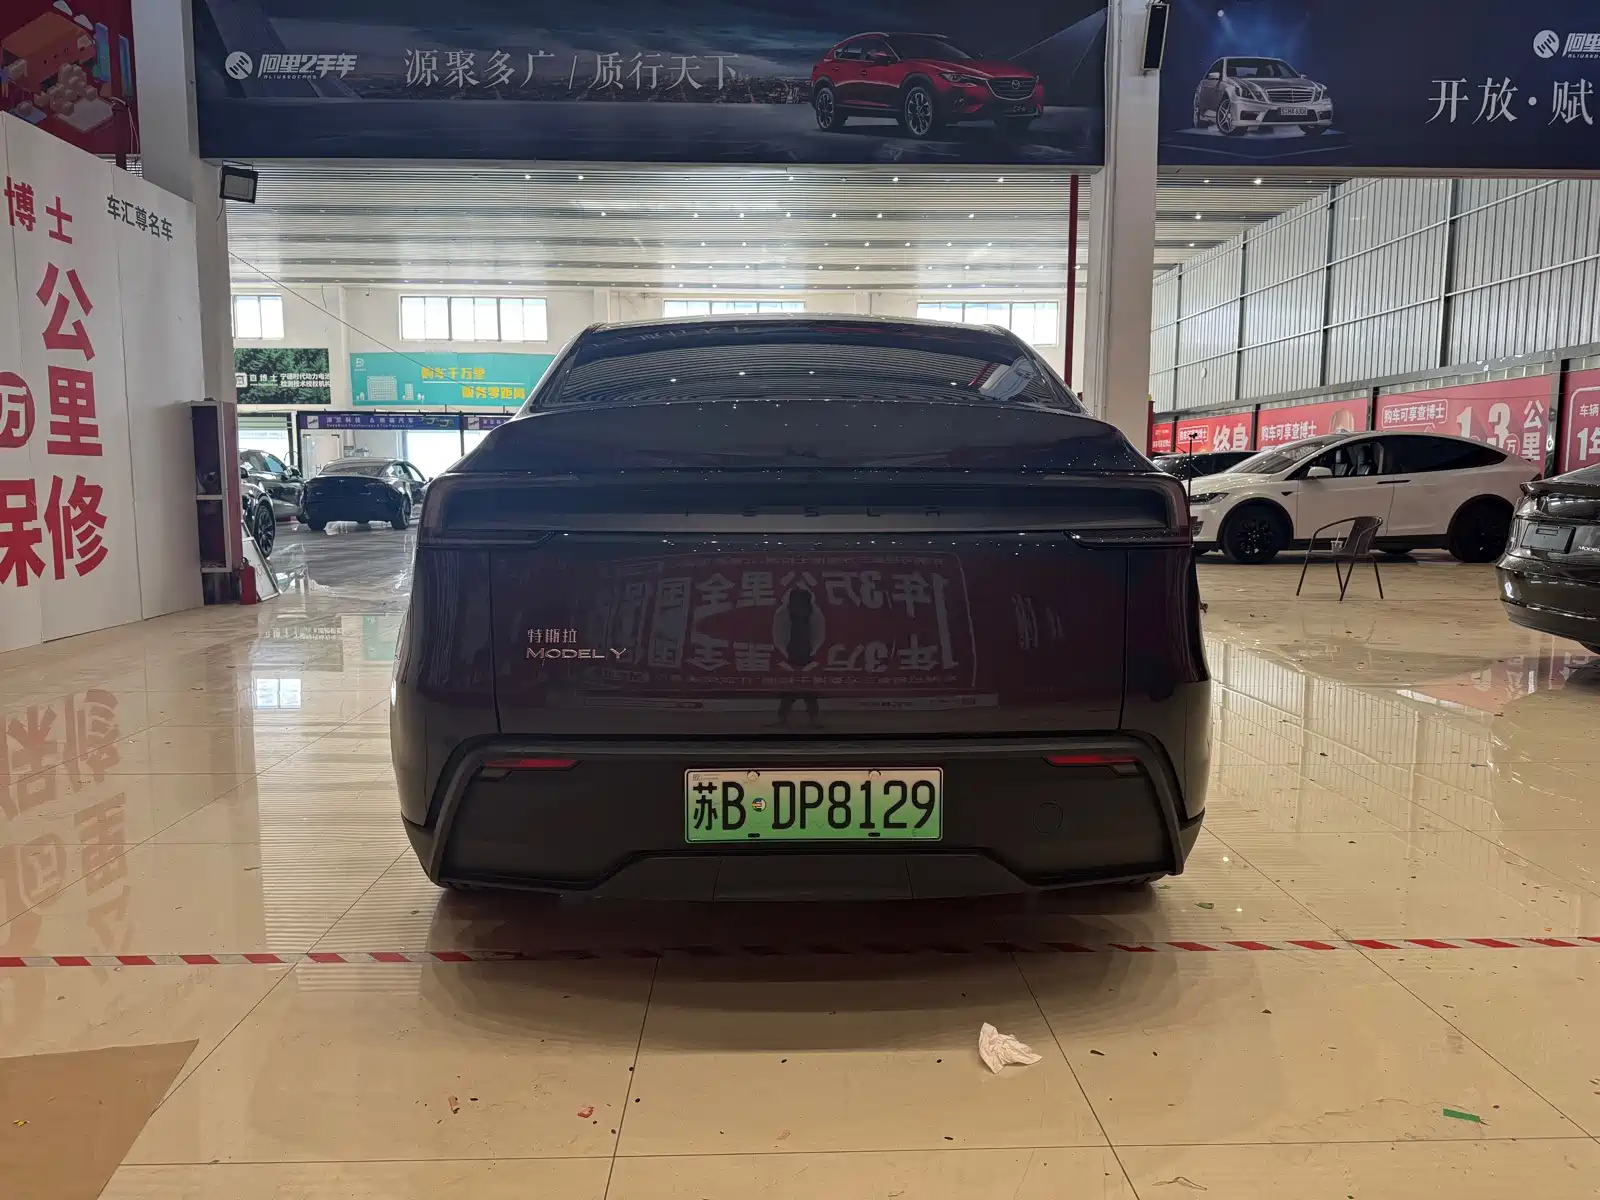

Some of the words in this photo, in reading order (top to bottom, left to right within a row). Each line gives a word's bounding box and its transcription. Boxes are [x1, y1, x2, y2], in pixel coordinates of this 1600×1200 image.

[3, 175, 73, 245] 博士
[106, 194, 173, 242] 车汇尊名车
[35, 261, 104, 457] 公里
[1260, 420, 1317, 443] 购车可享查博士
[1383, 403, 1446, 424] 购车可享查博士
[0, 474, 109, 588] 保修
[525, 647, 605, 659] MODEL
[609, 647, 627, 659] Y
[527, 628, 578, 643] 特斯拉
[771, 780, 936, 830] DP8129
